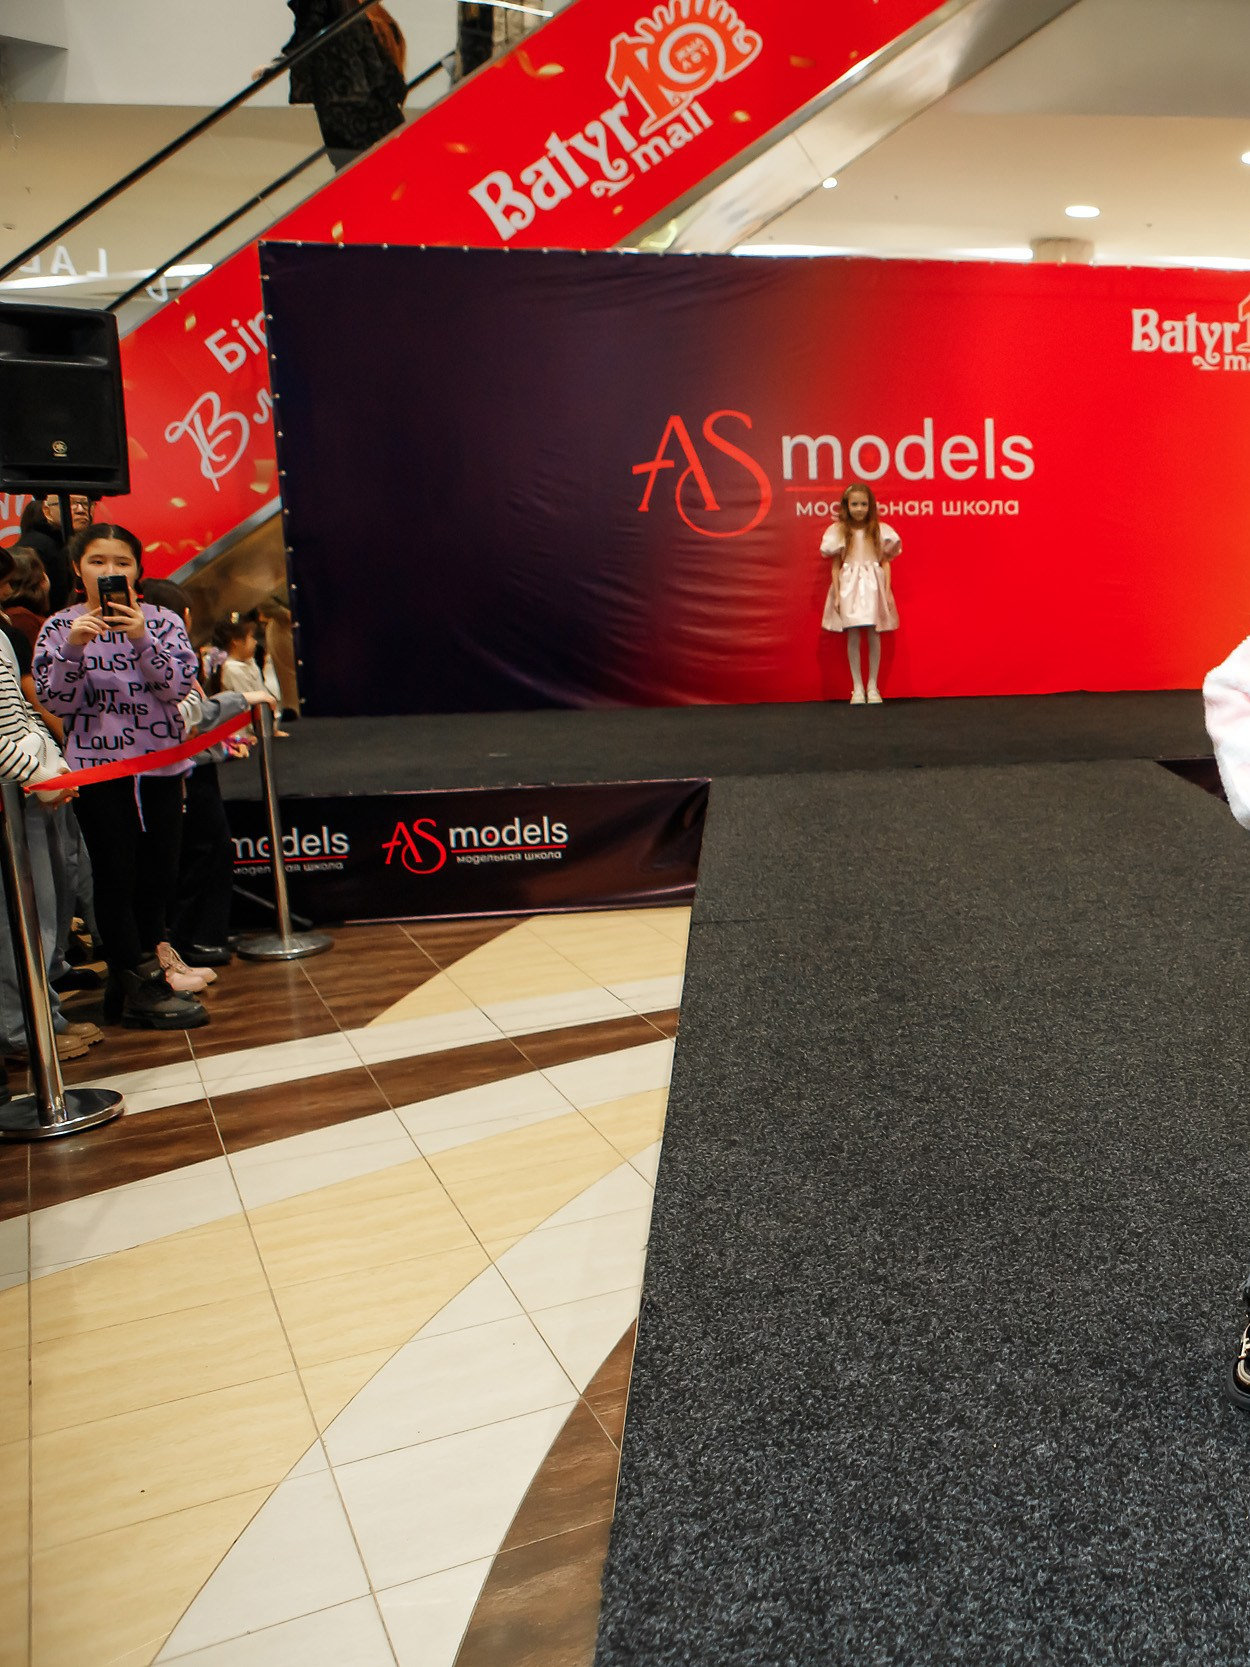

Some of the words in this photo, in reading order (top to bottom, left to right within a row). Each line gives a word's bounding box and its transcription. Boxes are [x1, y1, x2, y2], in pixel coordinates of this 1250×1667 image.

[629, 101, 714, 173] mall
[468, 100, 638, 241] Batyr
[1131, 308, 1240, 371] Batyr
[632, 409, 773, 539] AS
[781, 417, 1035, 481] models
[796, 501, 934, 522] модьная
[941, 499, 1019, 516] школа
[75, 727, 136, 750] LOUIS
[303, 861, 344, 873] школа
[381, 817, 447, 875] AS
[449, 816, 569, 848] models
[456, 852, 522, 866] модельная
[524, 850, 563, 861] школа
